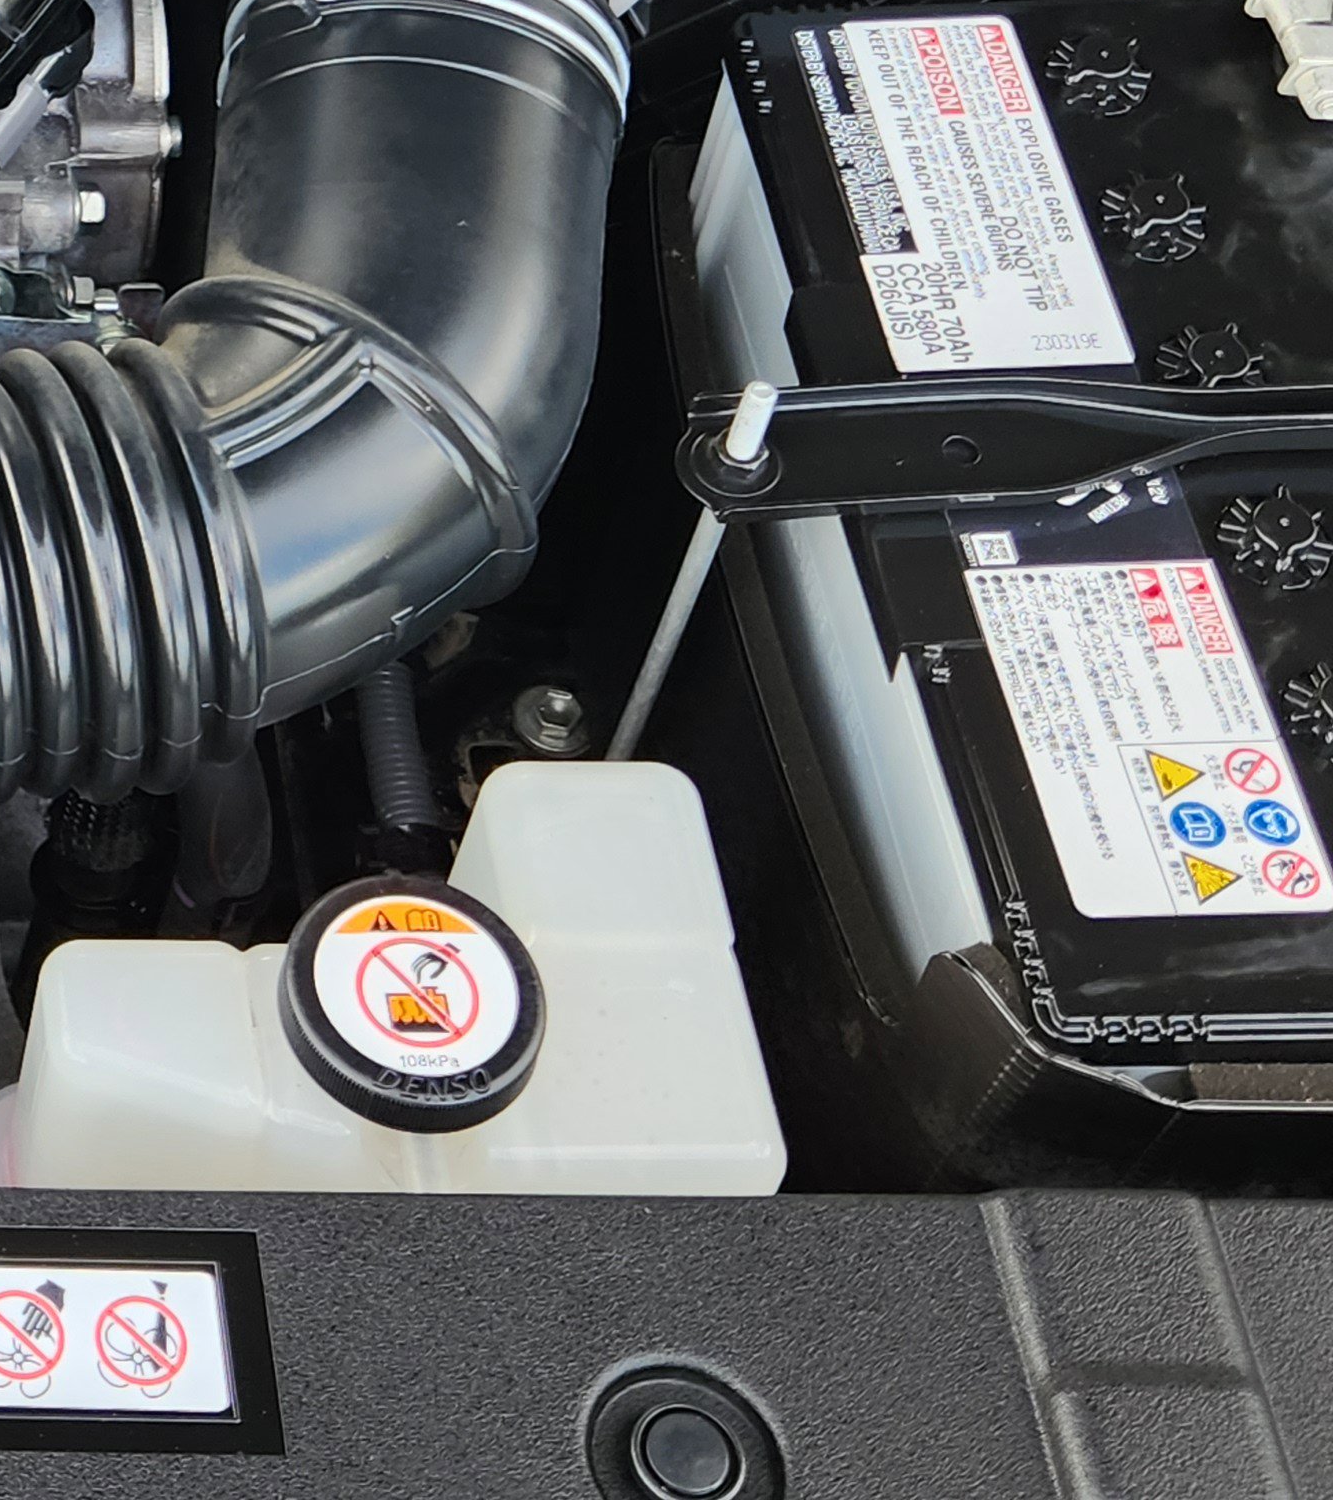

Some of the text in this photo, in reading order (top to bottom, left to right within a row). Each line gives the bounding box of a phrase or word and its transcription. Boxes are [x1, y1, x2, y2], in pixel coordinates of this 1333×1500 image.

[864, 28, 969, 290] KEEP OUT OF THE REACH OF CHILDREN
[917, 44, 1015, 271] POISON CAUSES SEVERE BURNS
[982, 40, 1075, 242] DANGER EXPLOSIVE GASES
[870, 264, 917, 340] D26(JIS)
[894, 263, 947, 355] CCA 580A
[997, 215, 1049, 311] DO NOT TIP
[919, 261, 976, 363] 20HR 70Ah
[1139, 597, 1179, 646] 危険
[1186, 593, 1232, 652] DANGER
[373, 1068, 493, 1103] DENSO
[399, 1054, 460, 1069] 108kPa
